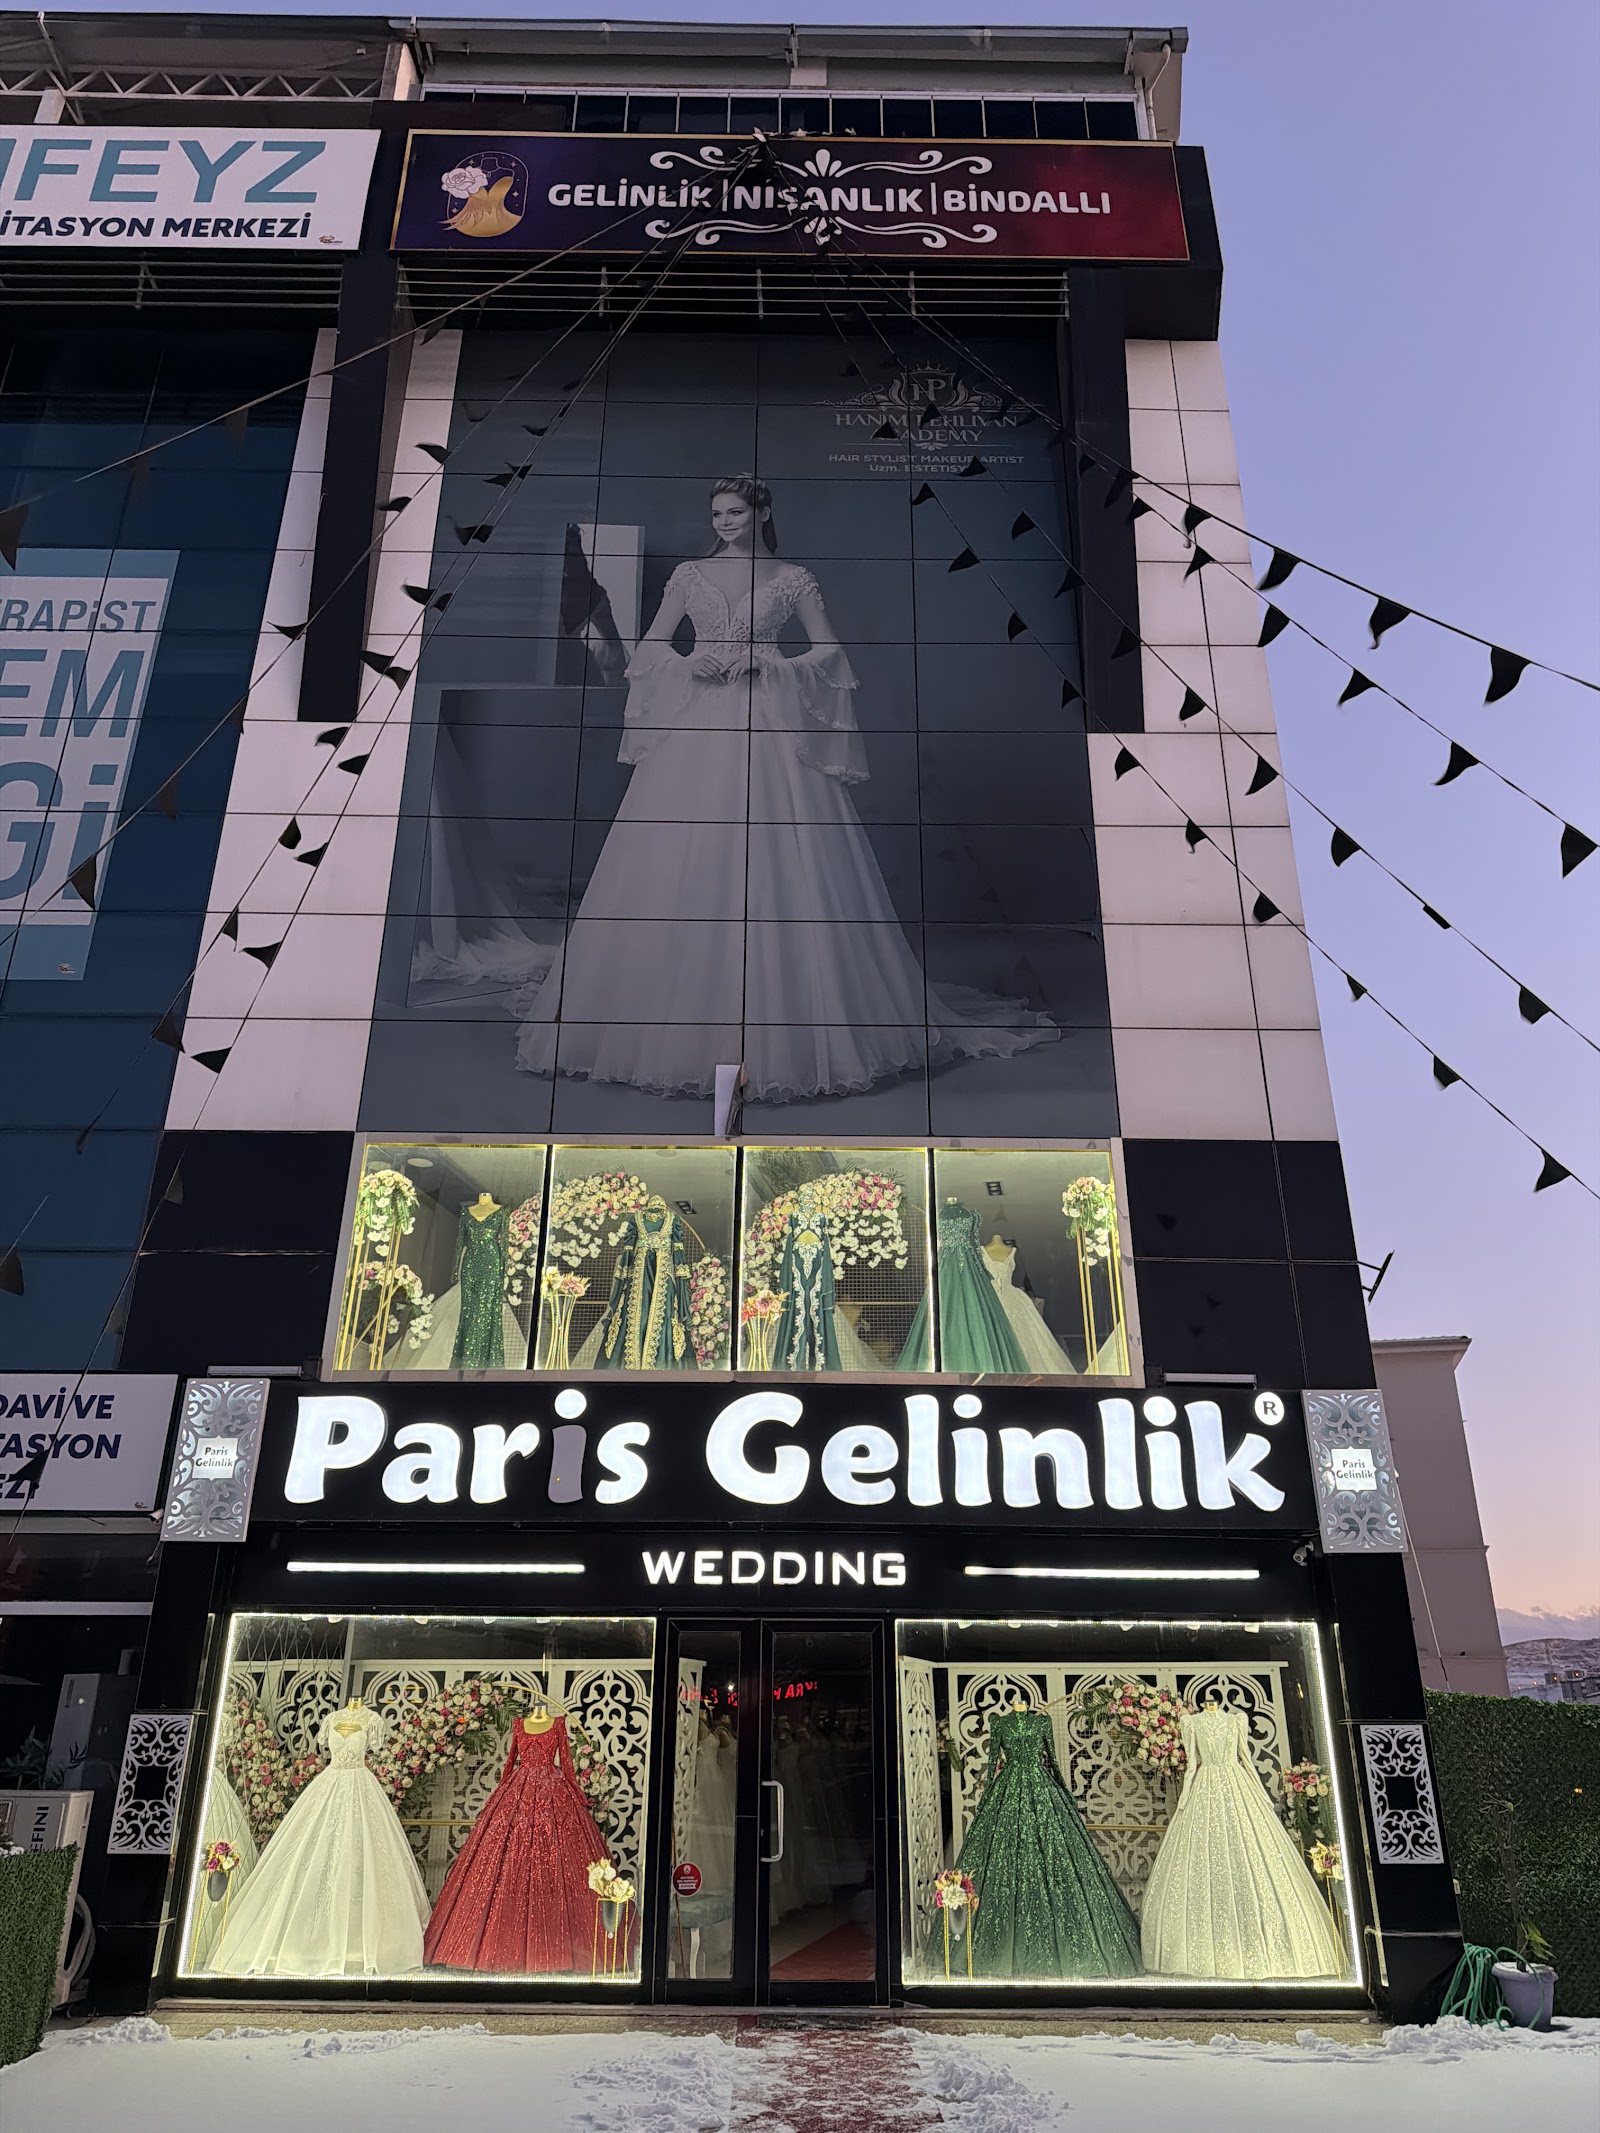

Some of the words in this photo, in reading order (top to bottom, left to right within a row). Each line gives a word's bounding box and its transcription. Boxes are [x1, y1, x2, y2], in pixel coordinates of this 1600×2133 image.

[547, 177, 713, 208] GELİNLİK
[943, 184, 1110, 214] BİNDALLI
[161, 212, 312, 238] MERKEZİ
[74, 1394, 115, 1419] VE
[195, 1457, 233, 1467] Gelinlik
[204, 1446, 228, 1456] Paris
[284, 1388, 651, 1504] Paris
[705, 1390, 1286, 1512] Gelinlik
[1336, 1469, 1374, 1479] Gelinlik
[1342, 1459, 1366, 1469] Paris
[642, 1550, 908, 1587] WEDDING
